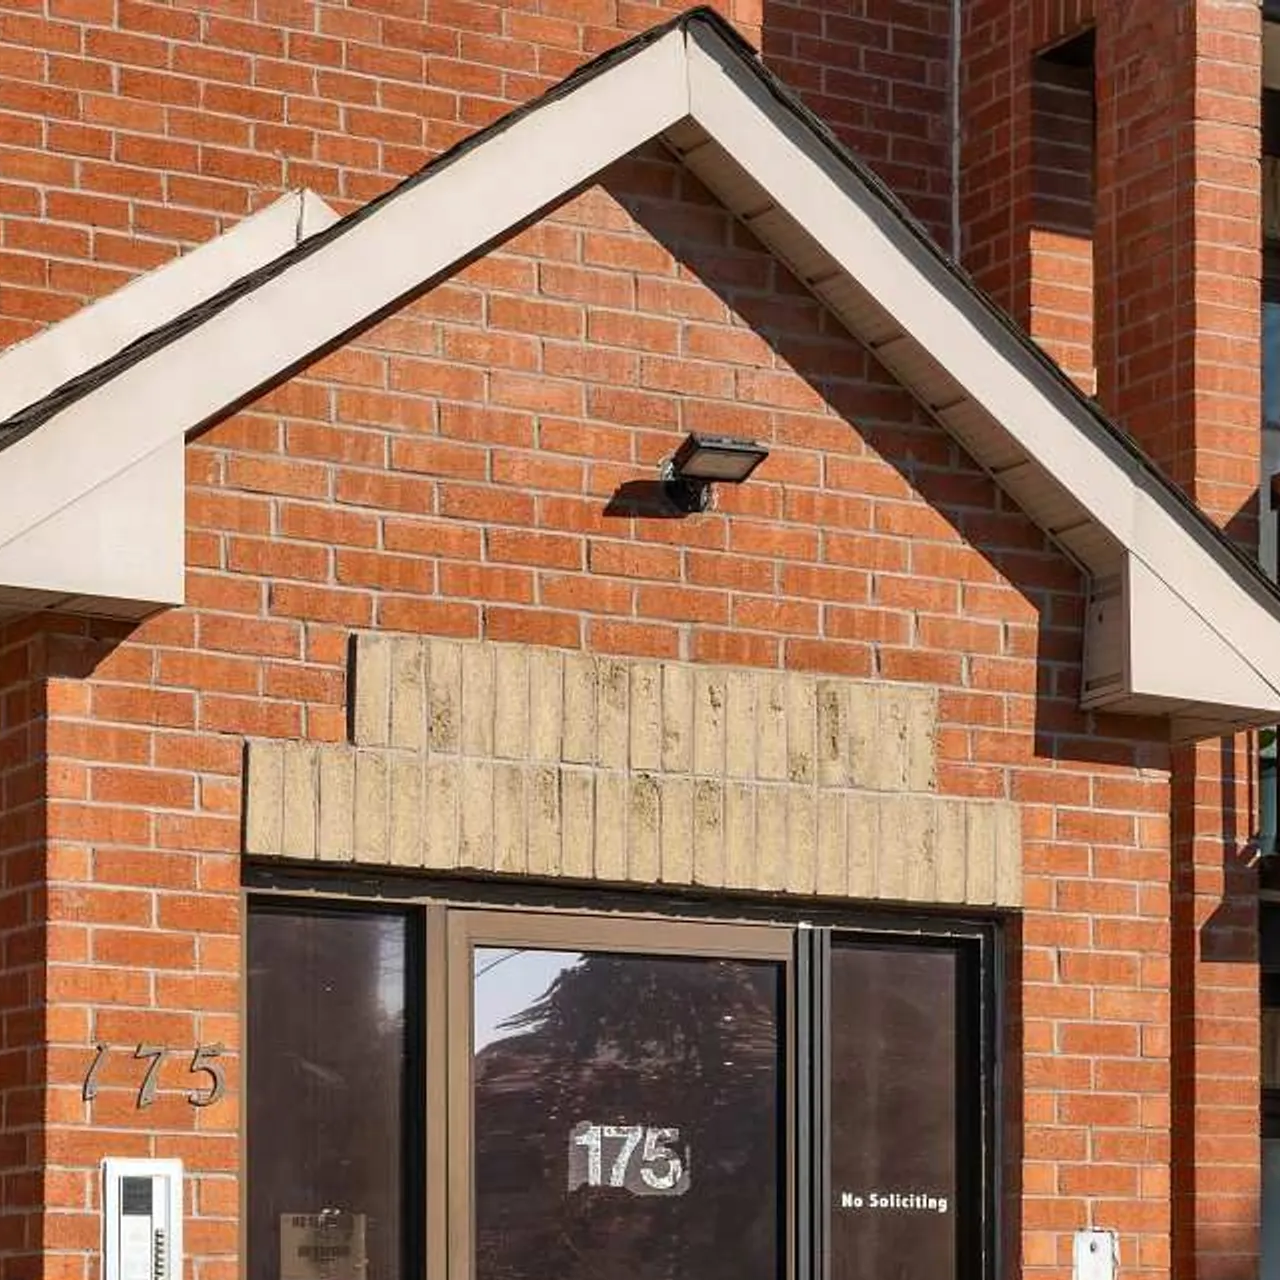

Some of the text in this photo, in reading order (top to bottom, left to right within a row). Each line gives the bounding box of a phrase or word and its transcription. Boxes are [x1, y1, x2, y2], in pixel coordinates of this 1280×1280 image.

[575, 1125, 682, 1189] 175
[841, 1192, 947, 1213] No Soliciting
